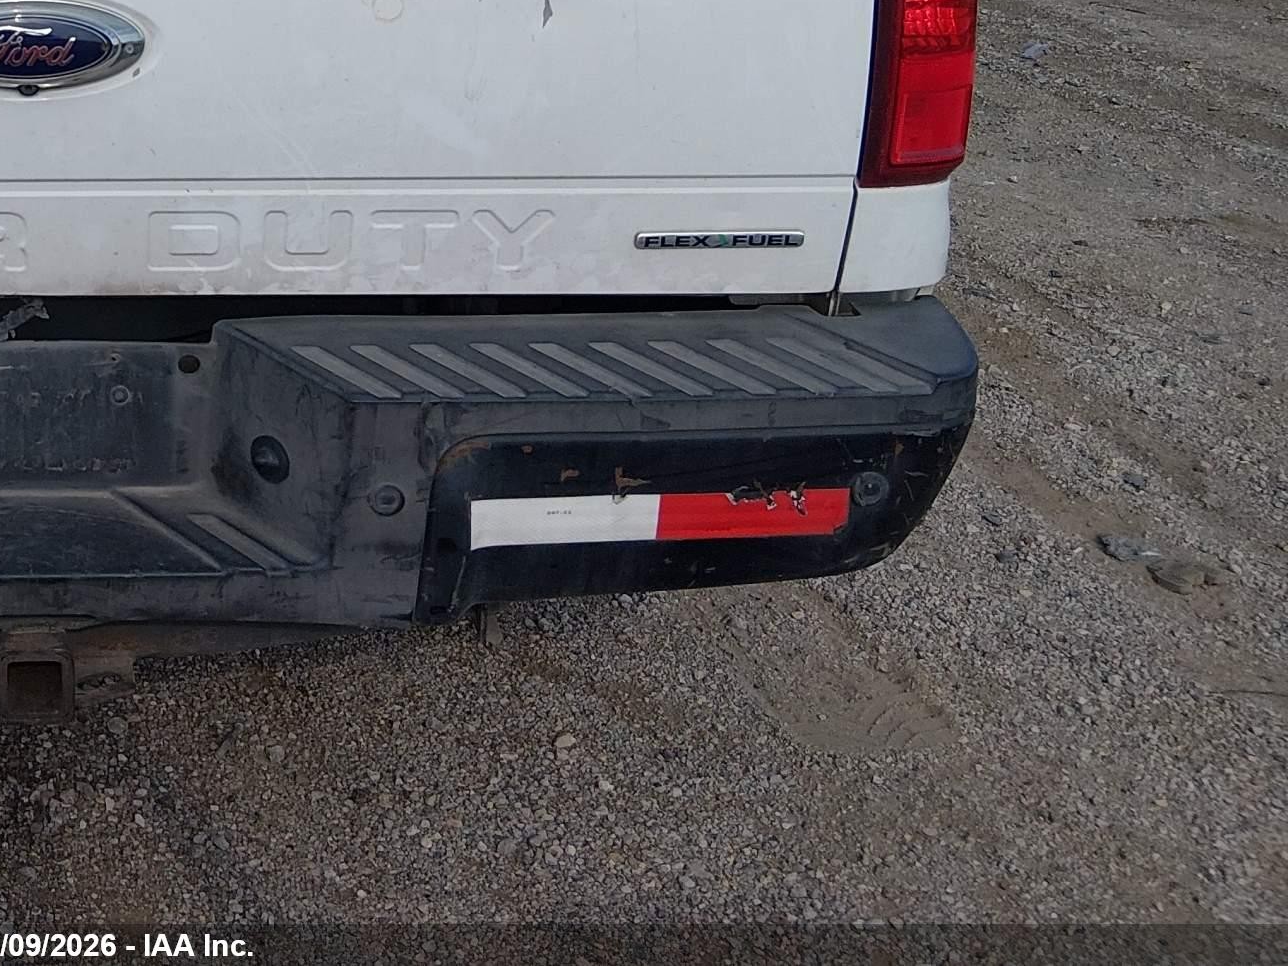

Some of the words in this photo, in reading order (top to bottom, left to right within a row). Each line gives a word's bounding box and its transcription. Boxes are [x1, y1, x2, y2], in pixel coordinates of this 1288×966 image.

[147, 209, 556, 272] DUTY
[643, 236, 710, 248] FLEX
[732, 234, 799, 247] FUEL
